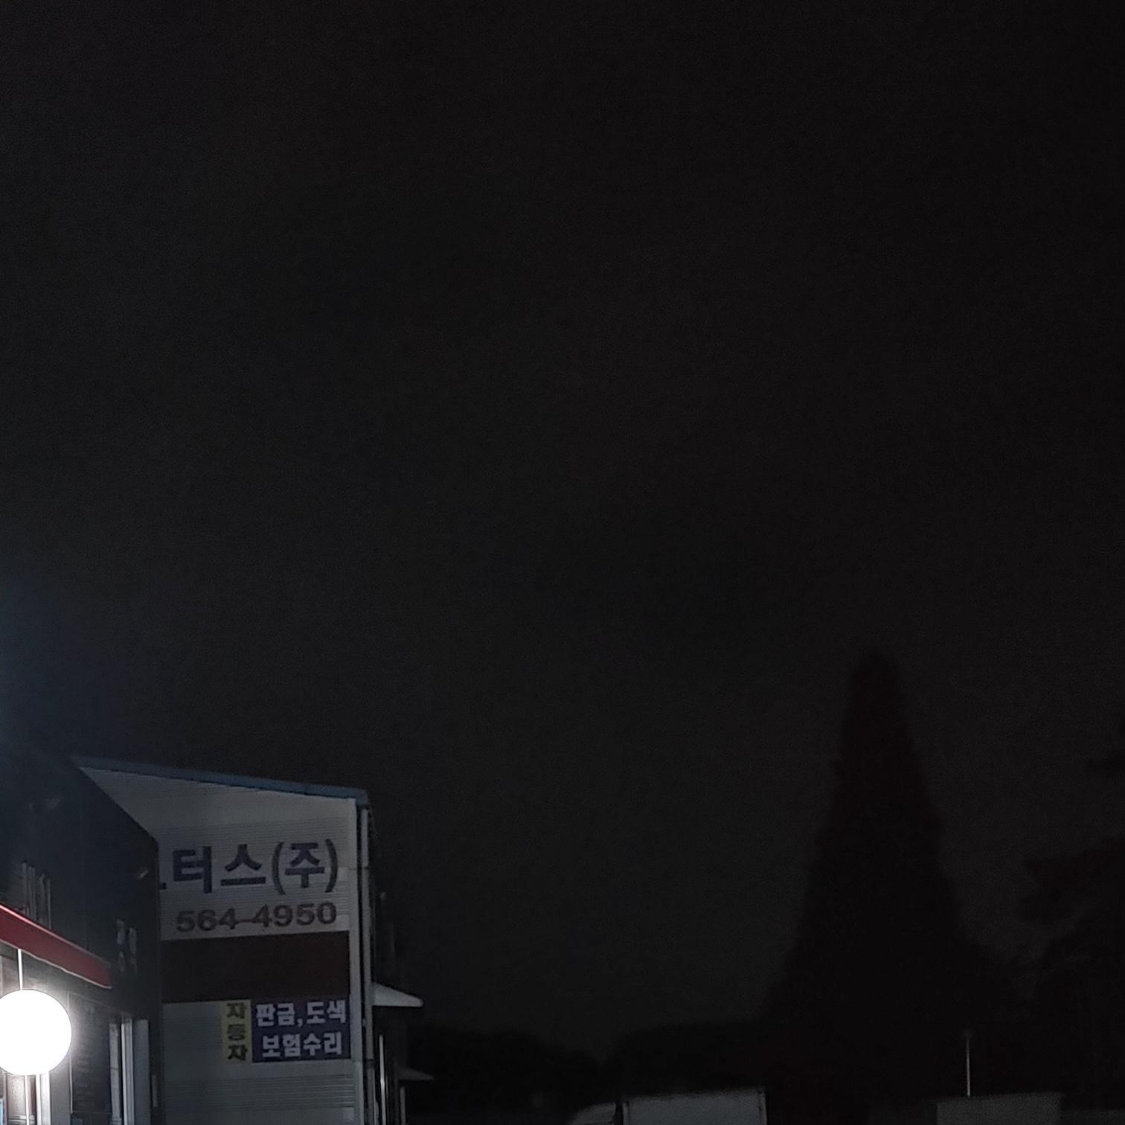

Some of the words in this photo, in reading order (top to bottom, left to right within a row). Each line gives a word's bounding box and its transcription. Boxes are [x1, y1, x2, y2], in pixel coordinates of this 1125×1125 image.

[160, 838, 338, 895] 터스(주)
[176, 902, 338, 933] 564-4950
[262, 1031, 343, 1058] 보험수리
